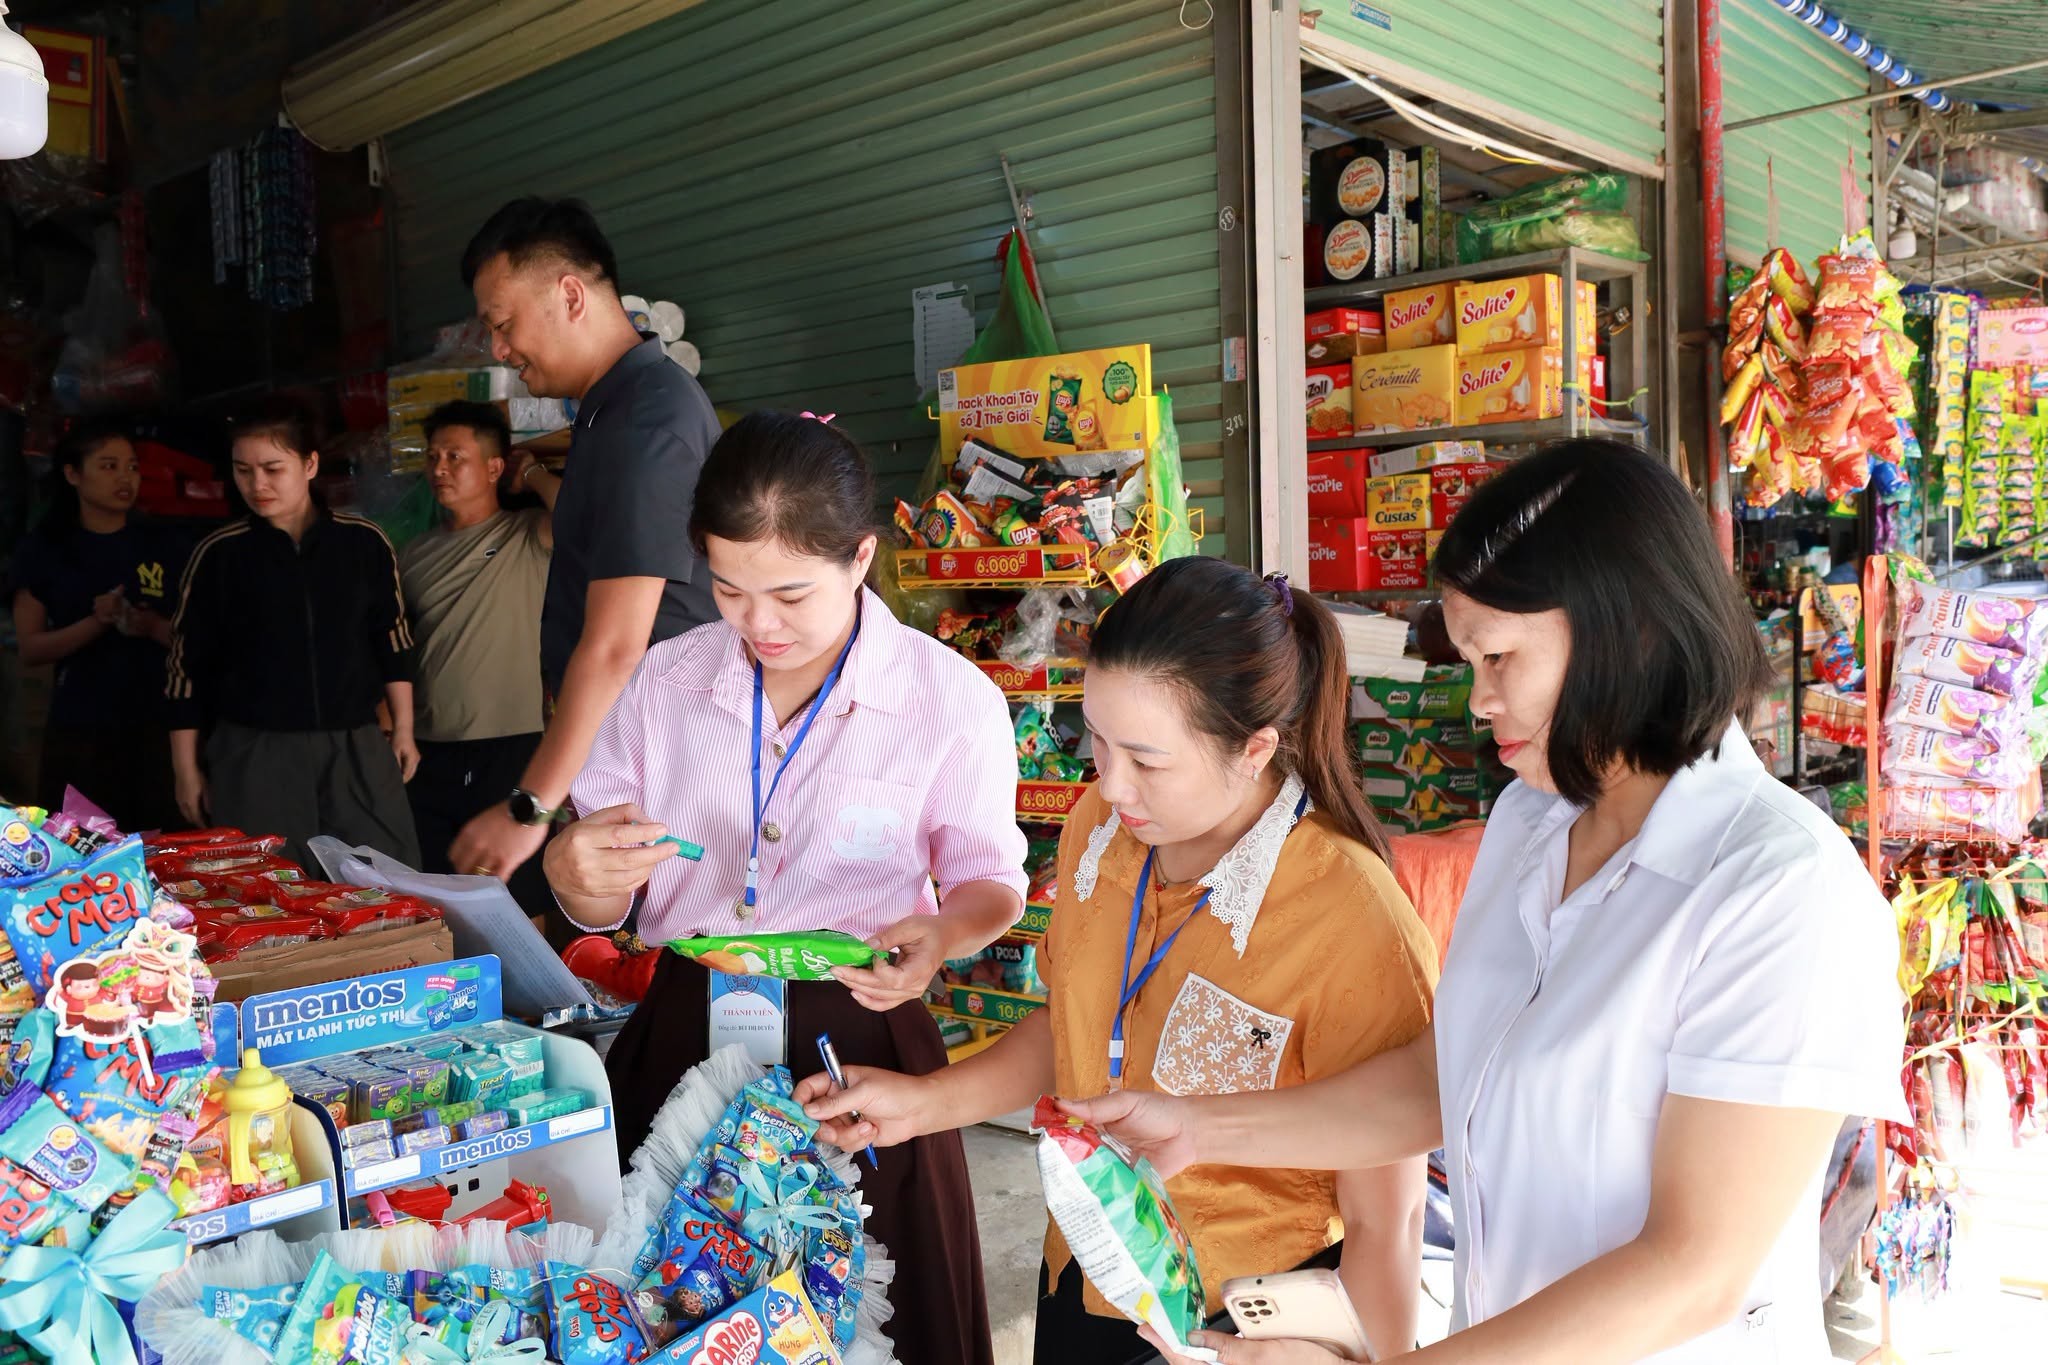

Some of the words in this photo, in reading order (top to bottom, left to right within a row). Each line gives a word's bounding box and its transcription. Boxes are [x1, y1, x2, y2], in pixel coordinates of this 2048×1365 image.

[1390, 301, 1428, 329] Solite
[1461, 296, 1508, 325] Solite
[1306, 379, 1328, 399] Zoll
[1459, 367, 1504, 396] Solite
[957, 396, 983, 410] nack
[986, 394, 1017, 407] Khoai
[1020, 390, 1039, 406] Tây
[960, 412, 973, 427] số
[974, 410, 982, 428] 1
[984, 411, 1003, 425] Thế
[1007, 409, 1031, 423] Giới
[1375, 511, 1417, 524] Custas
[1381, 576, 1419, 586] ChocoPie
[1390, 694, 1408, 702] MILO
[26, 871, 119, 937] Crab
[68, 882, 140, 946] Me!
[995, 946, 1021, 961] POCA
[255, 980, 406, 1031] mentos
[448, 984, 478, 1002] mentos
[723, 1008, 751, 1016] THÀNH
[754, 1008, 773, 1016] VIÊN
[257, 1027, 294, 1049] MÁT
[298, 1021, 343, 1042] LẠNH
[346, 1014, 377, 1031] TỨC
[380, 1006, 405, 1024] THÌ
[480, 1074, 504, 1089] Treat
[750, 1110, 805, 1142] Alpenliebe
[440, 1129, 531, 1169] mentos
[26, 1159, 65, 1190] BISCUIT
[490, 1266, 500, 1291] ZERO
[214, 1290, 224, 1318] ZERO
[350, 1291, 377, 1365] penliebe
[569, 1315, 580, 1338] Oishi
